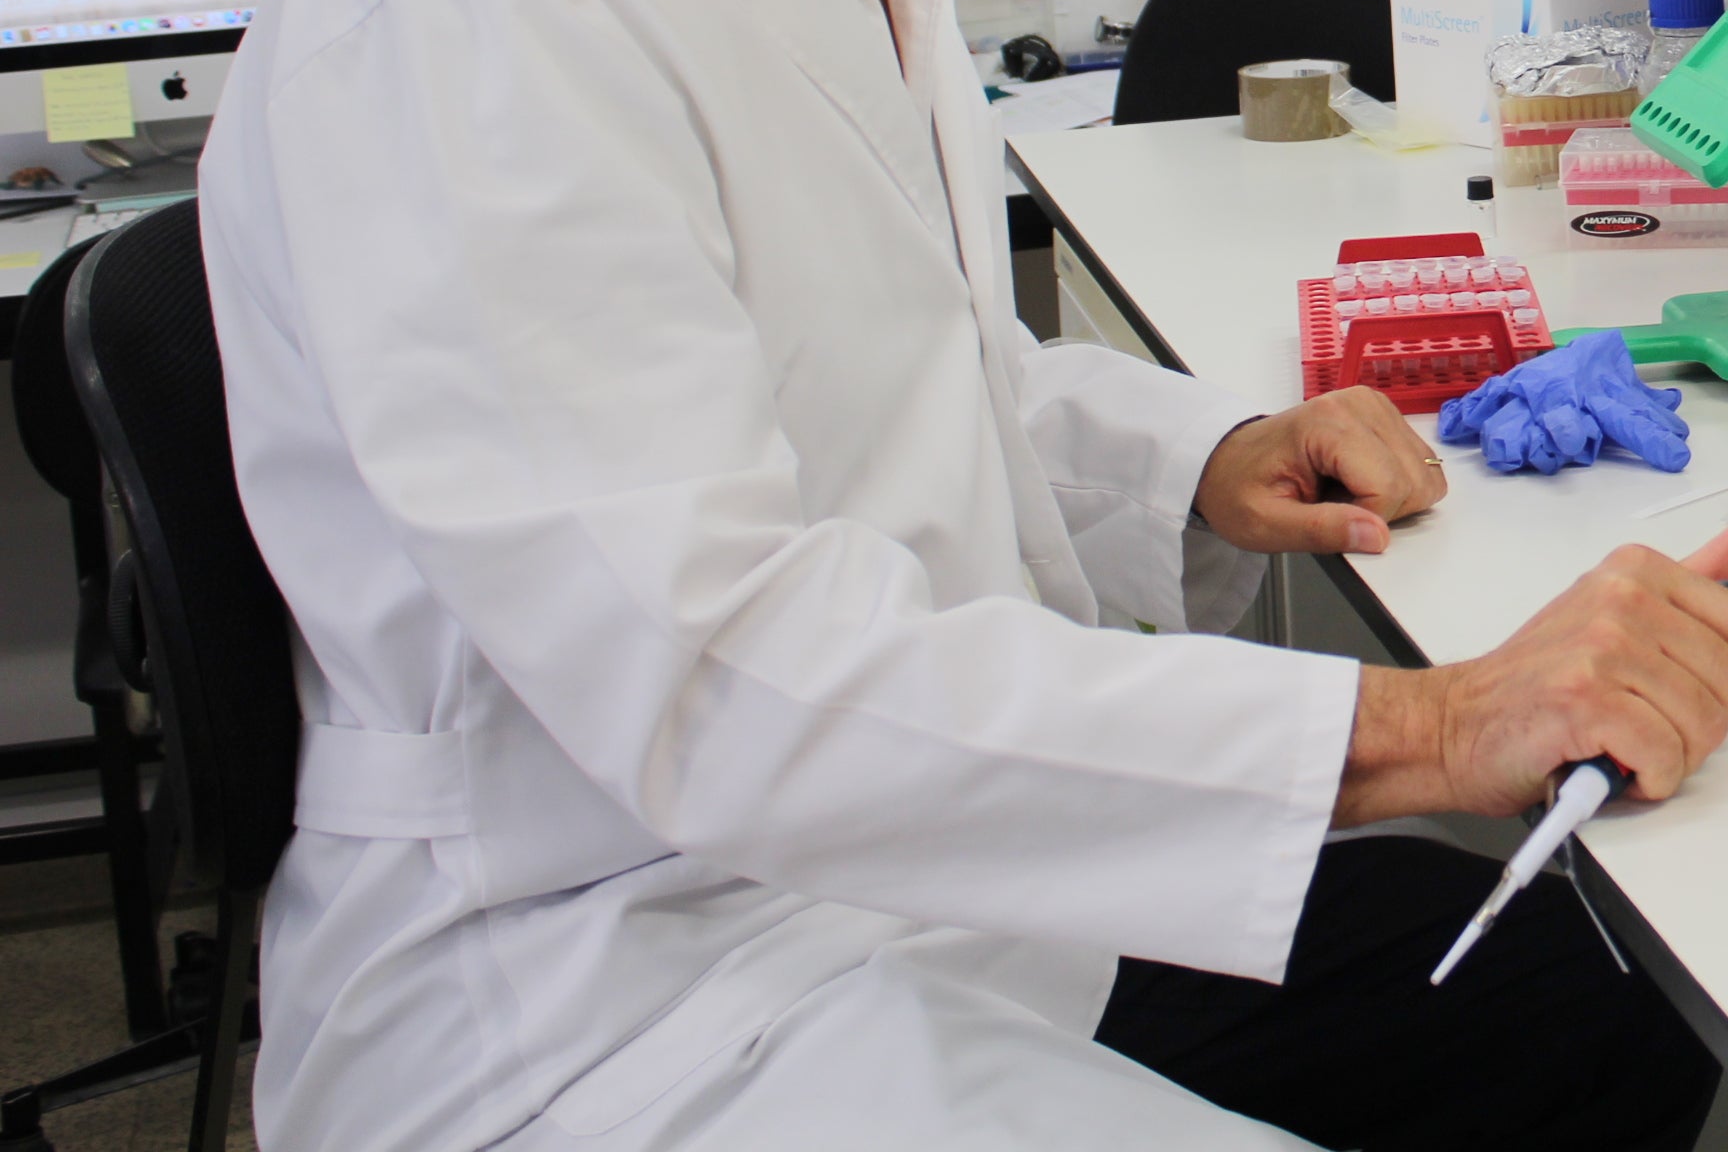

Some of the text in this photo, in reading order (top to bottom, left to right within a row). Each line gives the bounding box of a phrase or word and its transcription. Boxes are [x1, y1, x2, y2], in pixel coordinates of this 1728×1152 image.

[1400, 5, 1481, 34] MultiScreen
[1401, 32, 1440, 49] Filter Plates
[1583, 216, 1638, 225] MAXYMUM
